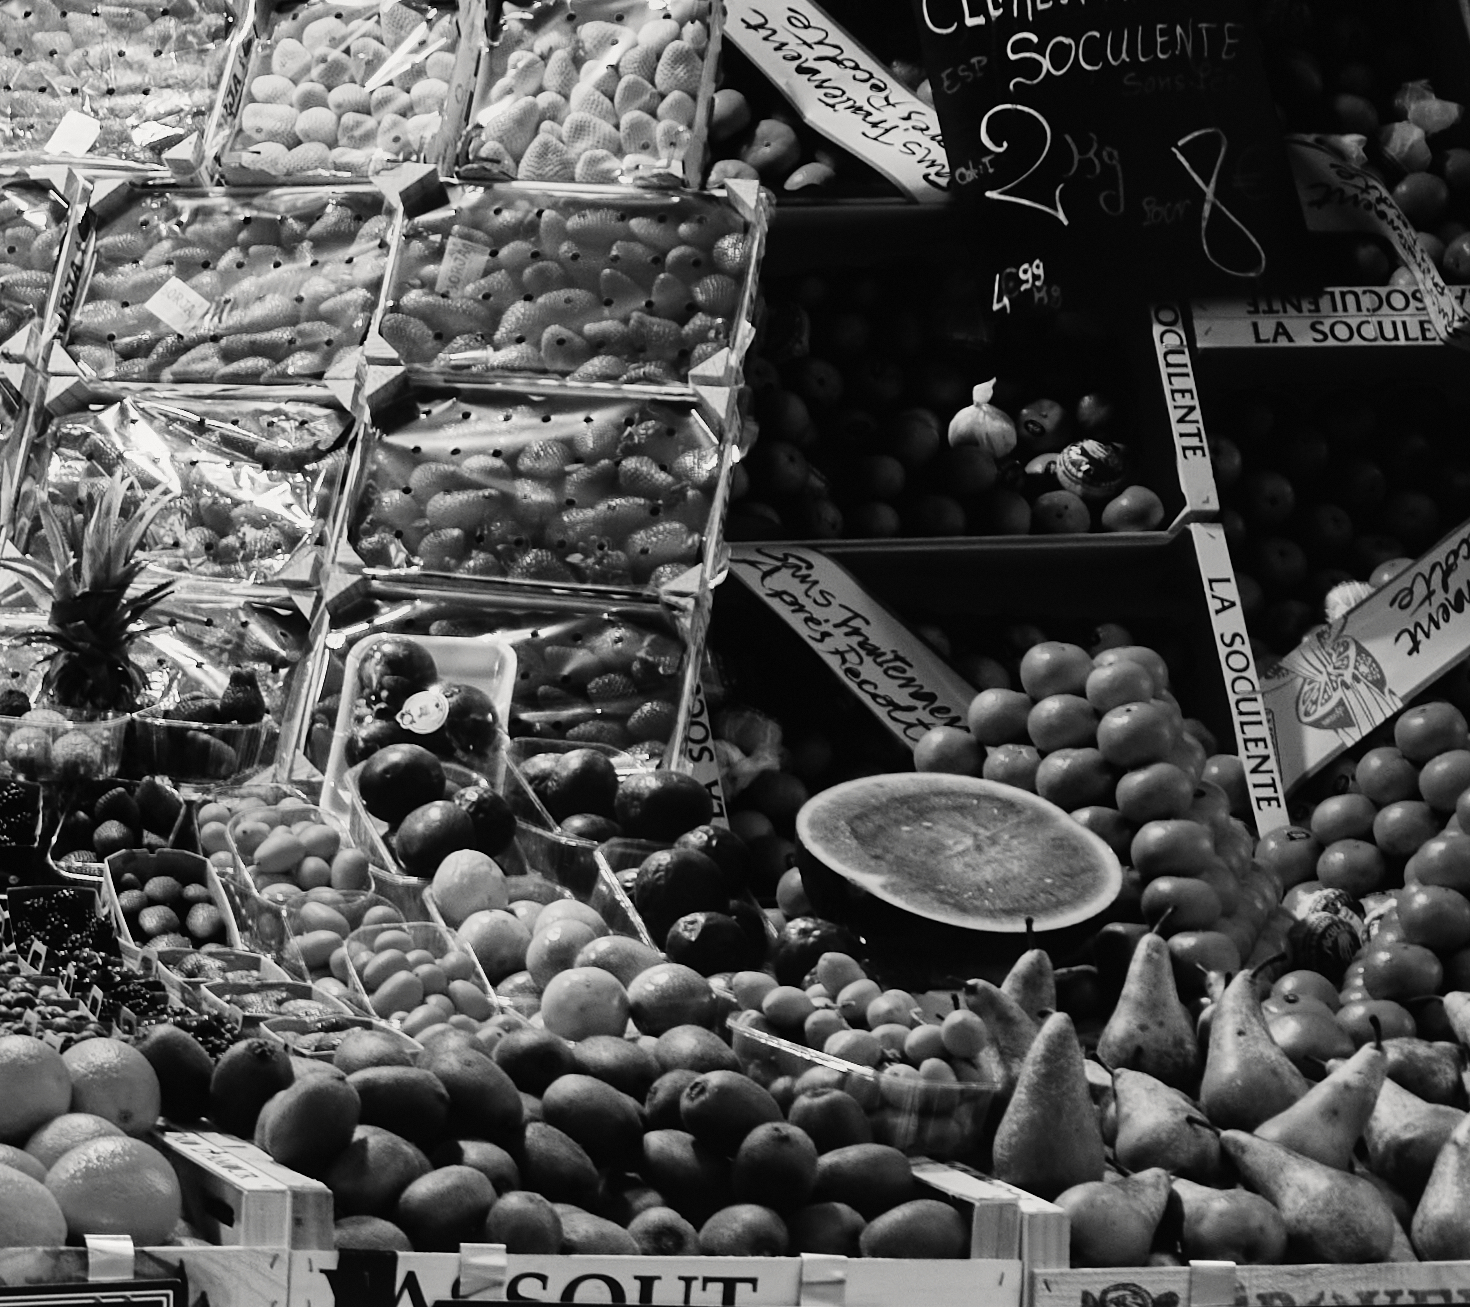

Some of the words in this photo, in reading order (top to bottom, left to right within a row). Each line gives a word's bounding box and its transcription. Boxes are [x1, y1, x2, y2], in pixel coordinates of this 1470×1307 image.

[1005, 21, 1245, 93] SOCULENTE
[1153, 302, 1209, 462] OCULENTE
[1251, 320, 1296, 344] LA
[1309, 319, 1438, 343] SOCULE
[1206, 575, 1235, 617] LA
[836, 599, 972, 734] Traitemen
[1218, 632, 1283, 812] SOCULENTE
